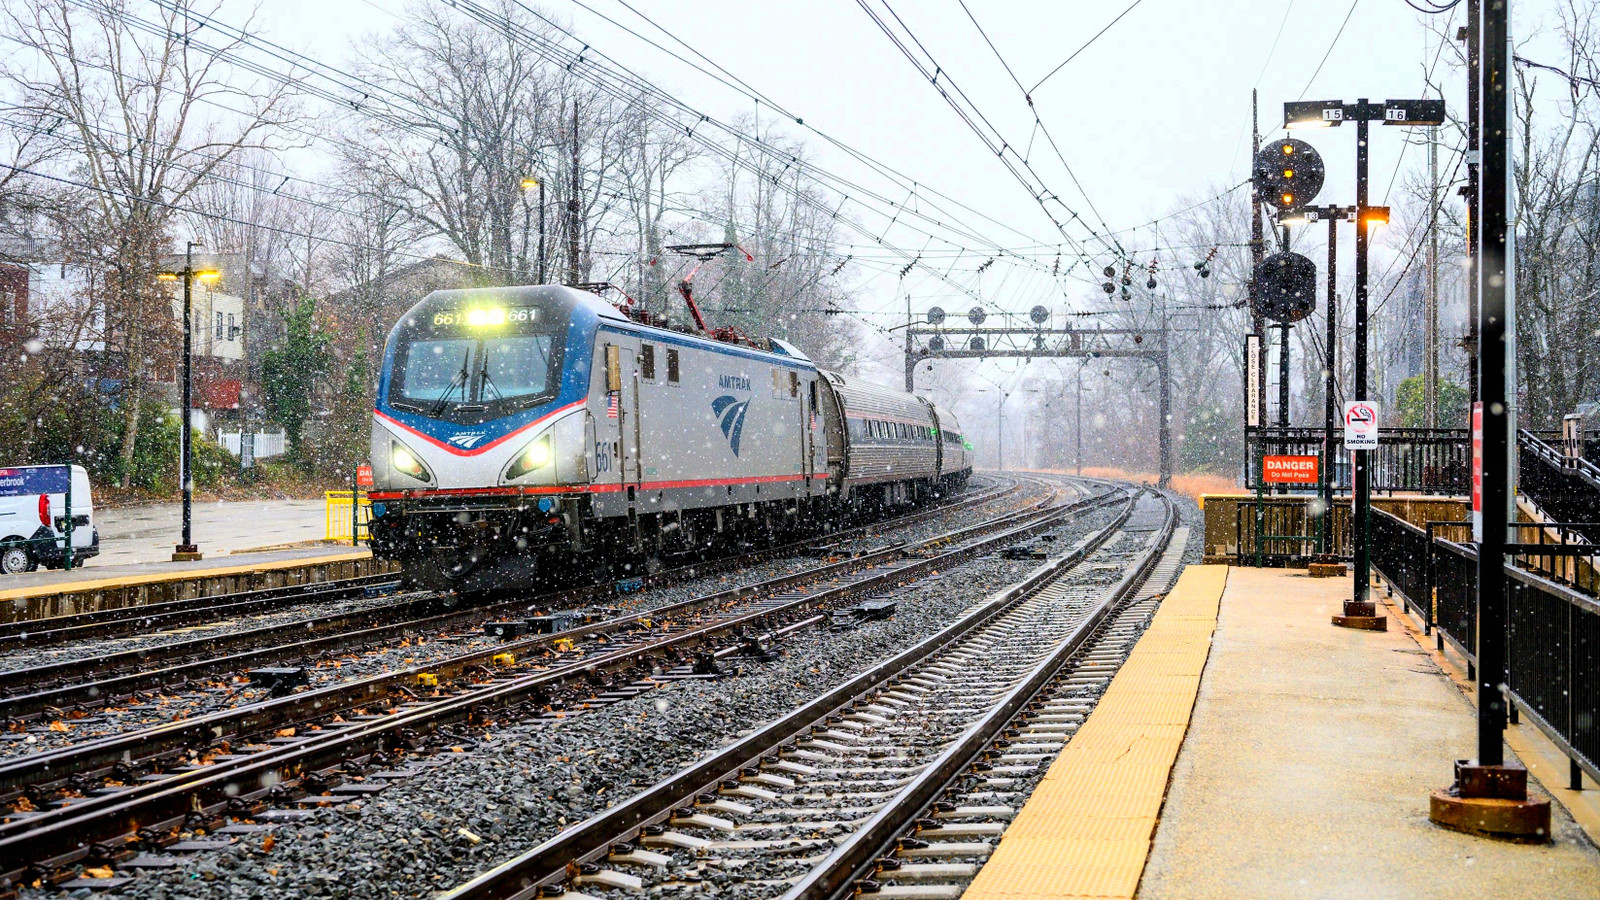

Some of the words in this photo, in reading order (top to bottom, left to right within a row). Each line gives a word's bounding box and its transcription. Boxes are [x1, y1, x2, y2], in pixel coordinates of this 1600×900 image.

[1325, 109, 1341, 119] 15
[1388, 109, 1404, 120] 16
[433, 313, 462, 326] 661
[507, 309, 536, 322] 661
[718, 373, 752, 391] AMTRAK
[596, 441, 612, 473] 661
[1267, 460, 1314, 471] DANGER
[1294, 471, 1310, 479] Pass
